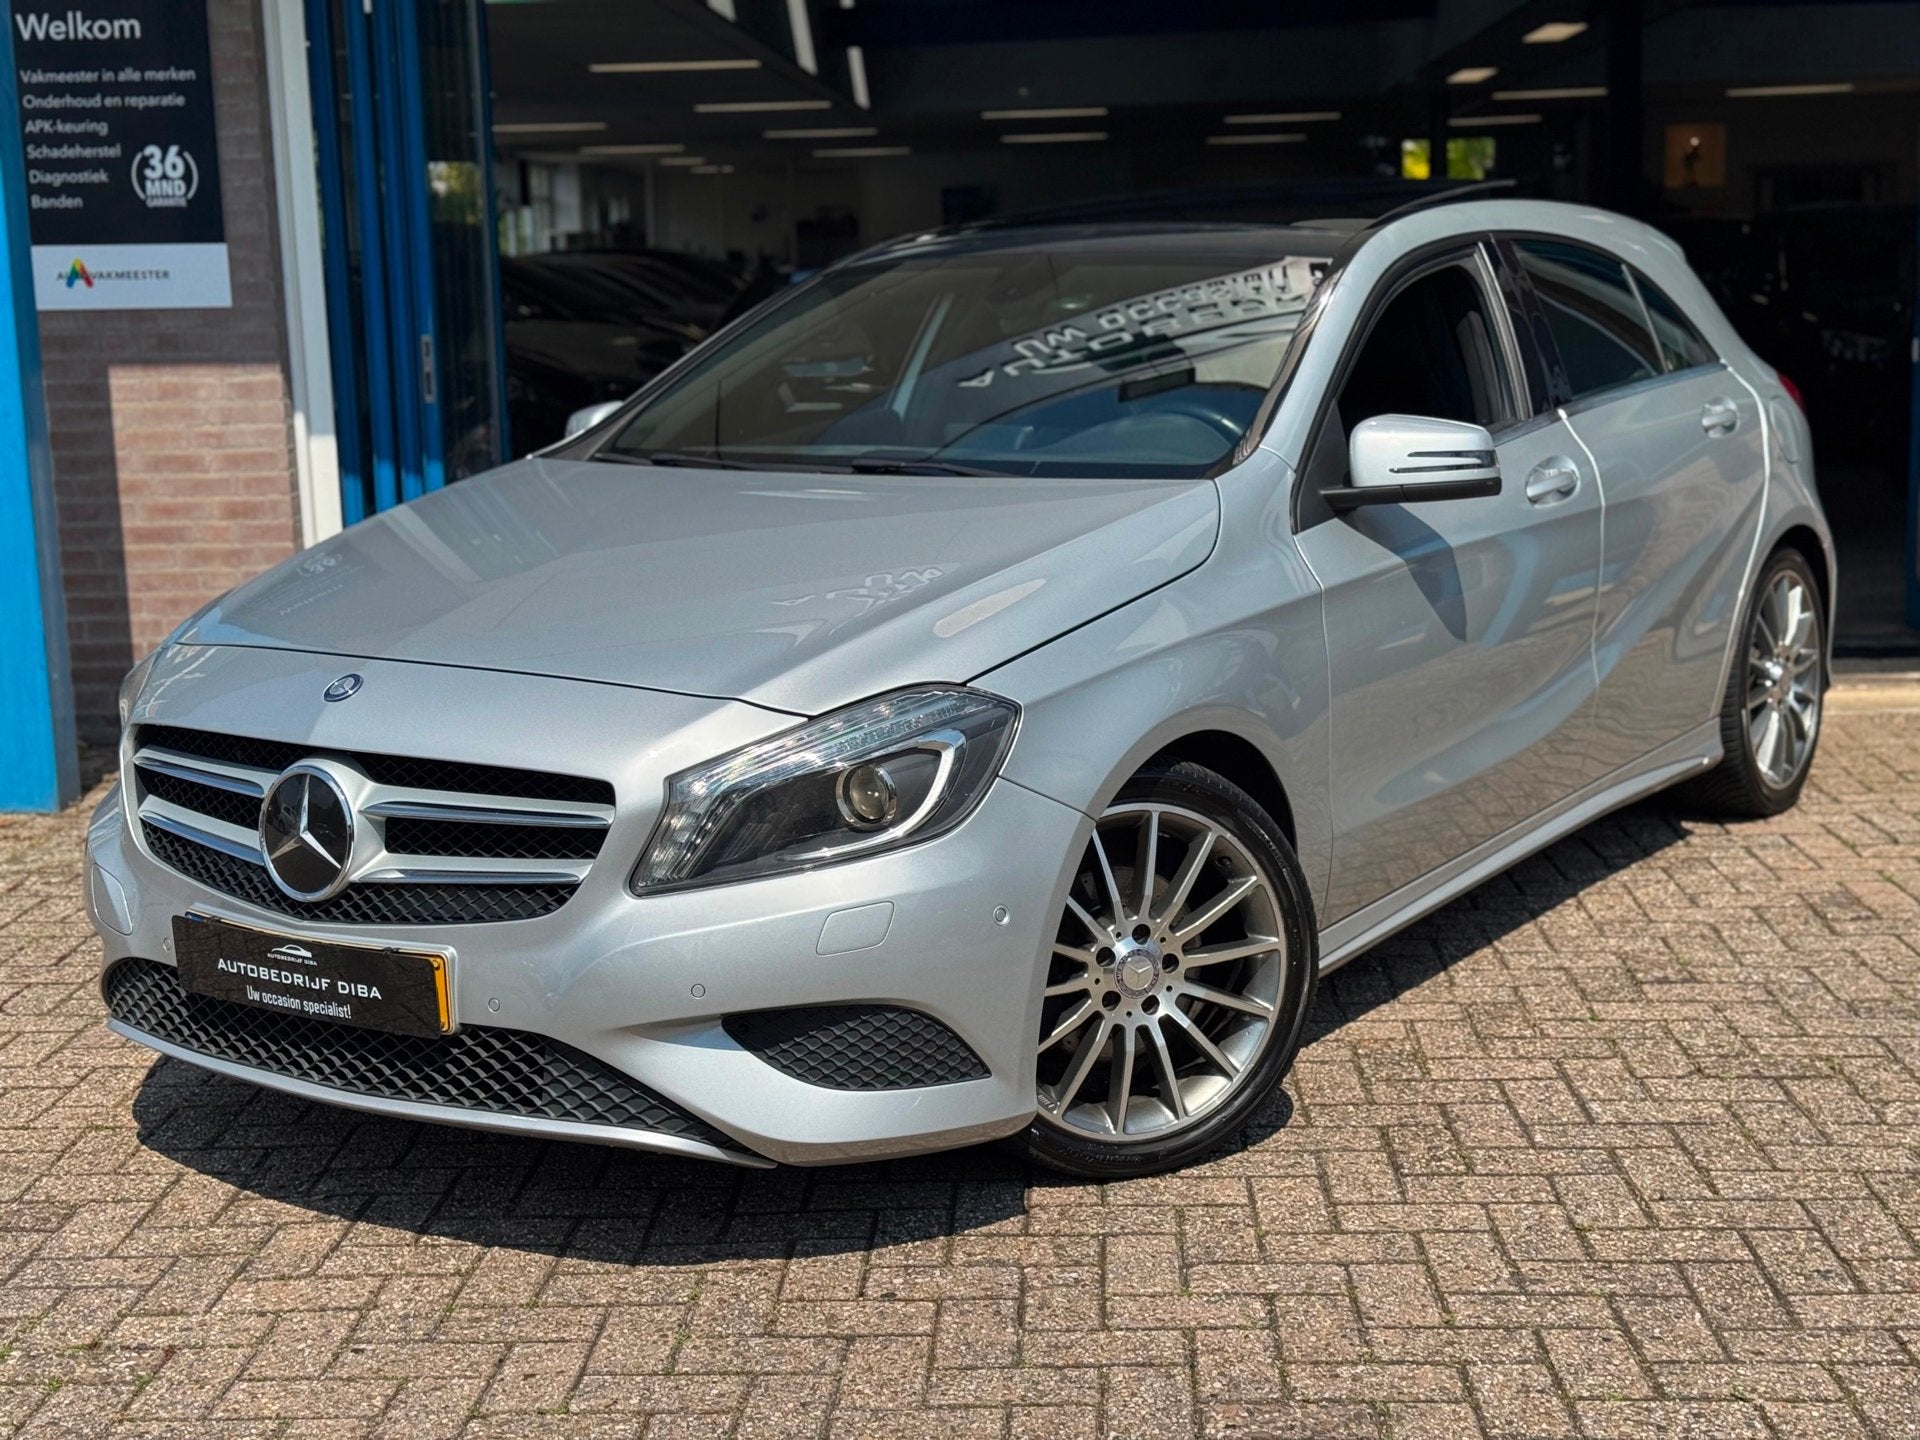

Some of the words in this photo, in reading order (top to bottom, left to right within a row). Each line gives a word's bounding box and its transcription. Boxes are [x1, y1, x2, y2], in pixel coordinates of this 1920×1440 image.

[15, 11, 142, 41] Welkom
[20, 69, 99, 84] Vakmeester
[101, 68, 115, 82] in
[117, 68, 142, 82] alle
[144, 67, 196, 82] merken
[22, 94, 102, 109] Onderhoud
[104, 95, 122, 107] en
[124, 92, 186, 110] reparatie
[25, 119, 109, 137] APK-keuring
[26, 143, 121, 160] Schadeherstel
[143, 145, 186, 179] 36
[28, 169, 109, 187] Diagnostiek
[145, 180, 187, 196] MND
[31, 194, 83, 209] Banden
[267, 952, 302, 963] AUTOBEDRIJF
[217, 958, 330, 990] AUTOBEDRIJF
[337, 981, 382, 1000] DIBA
[246, 985, 260, 1001] Uw
[262, 992, 301, 1010] occasion
[303, 1000, 351, 1019] specialist!
